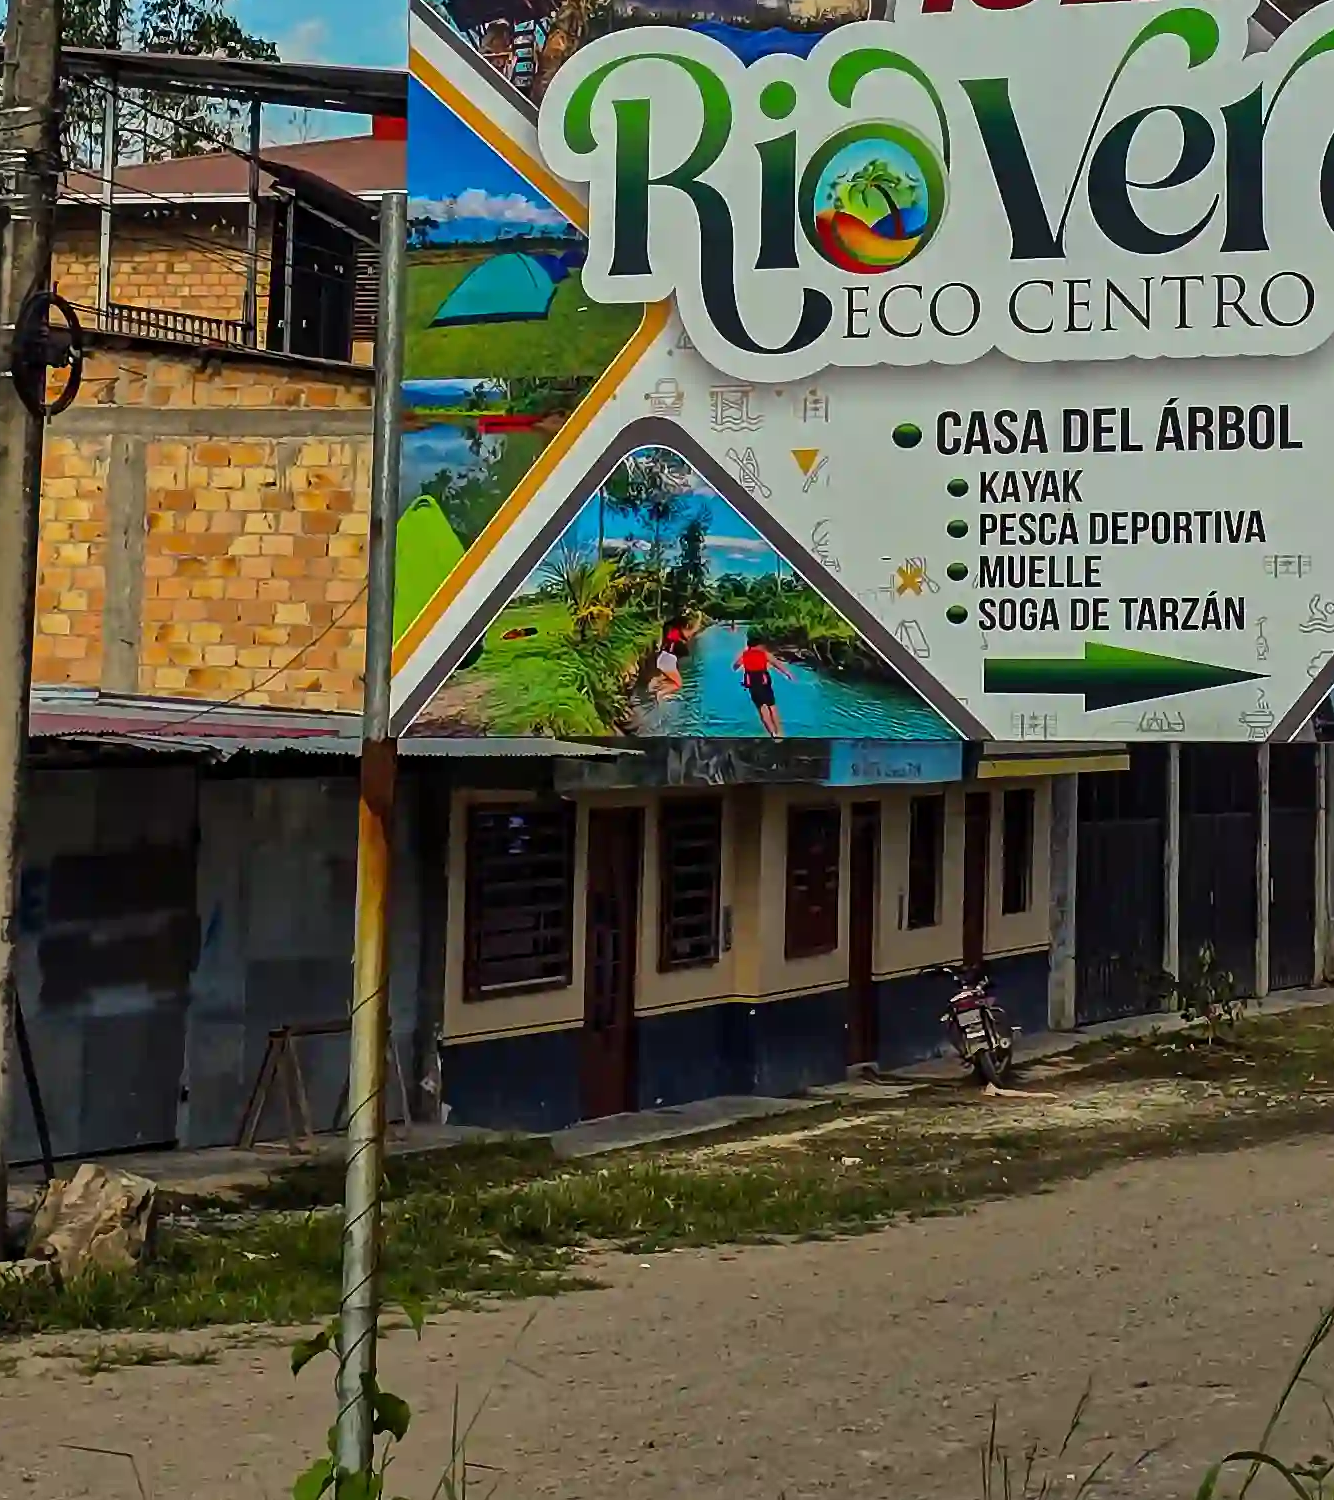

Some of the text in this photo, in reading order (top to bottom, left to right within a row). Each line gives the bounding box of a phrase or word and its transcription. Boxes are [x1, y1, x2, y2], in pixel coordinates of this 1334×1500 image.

[842, 271, 1316, 340] ECO CENTRO
[936, 397, 1303, 456] CASA DEL ÁRBOL
[979, 469, 1083, 503] KAYAK
[979, 509, 1266, 545] PESCA DEPORTIVA
[979, 555, 1101, 588] MUELLE
[978, 590, 1245, 631] SOGA DE TARZÁN
